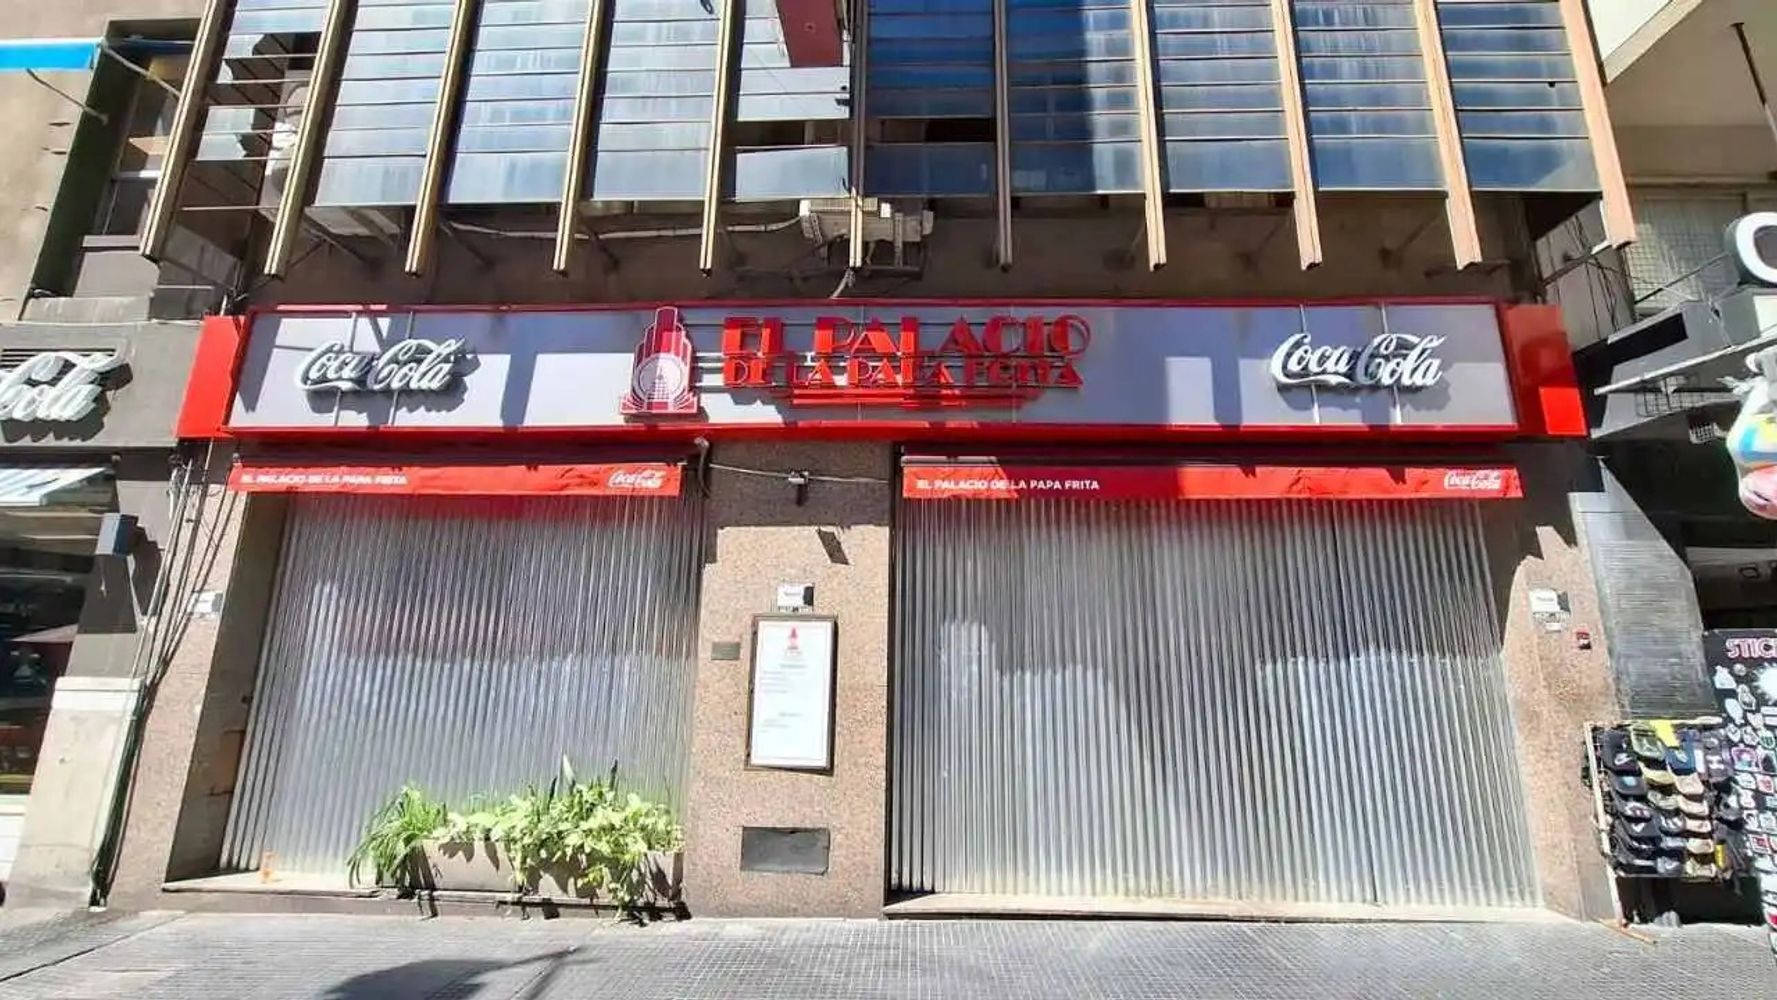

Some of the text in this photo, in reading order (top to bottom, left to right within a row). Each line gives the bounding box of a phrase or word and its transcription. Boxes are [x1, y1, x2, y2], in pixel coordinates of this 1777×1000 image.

[721, 313, 1091, 359] EL PALACIO
[296, 338, 465, 391] Coca-Cola
[723, 357, 776, 387] DE
[786, 357, 836, 386] LA
[1270, 333, 1446, 387] Coca-Cola
[255, 473, 306, 485] PALACIO
[916, 479, 1100, 490] EL PALACIO DE LA PAPA FRITA
[1725, 637, 1777, 658] STIC
